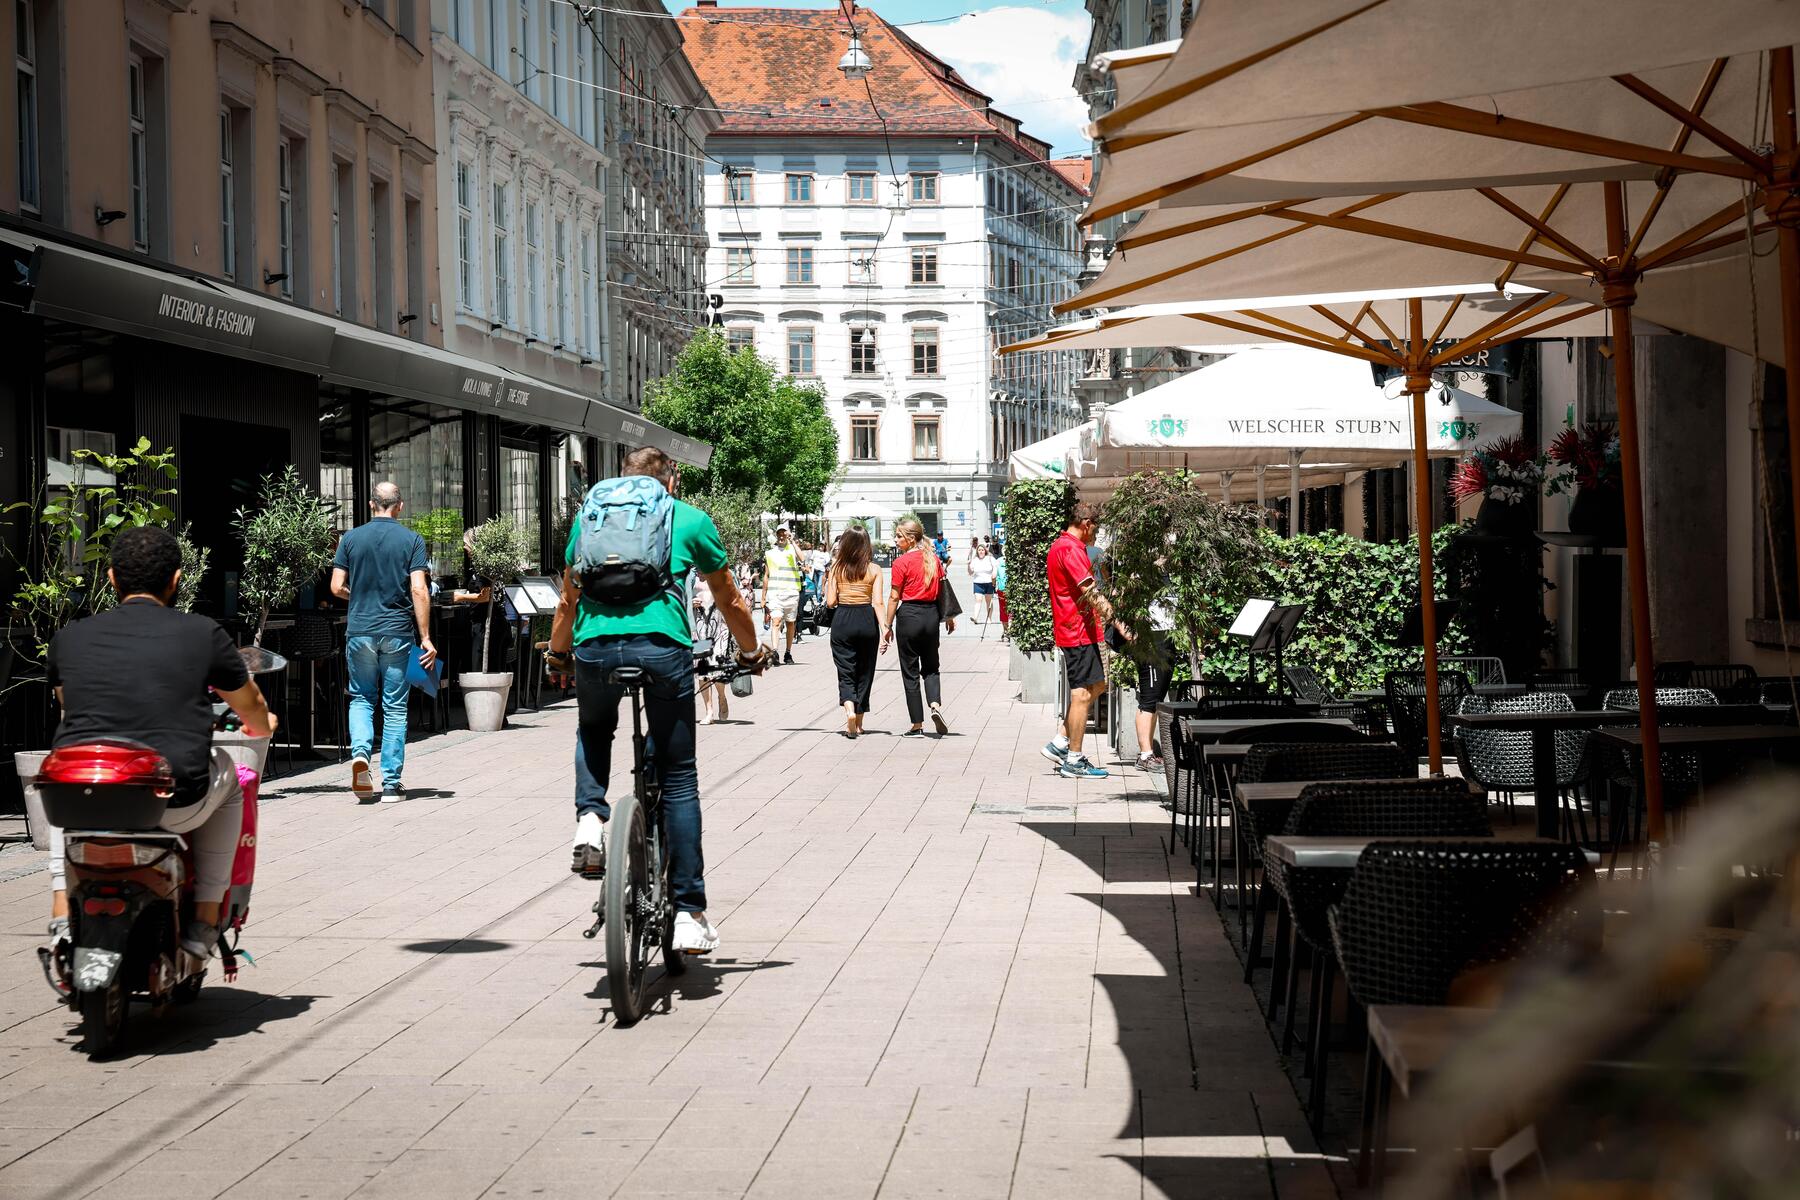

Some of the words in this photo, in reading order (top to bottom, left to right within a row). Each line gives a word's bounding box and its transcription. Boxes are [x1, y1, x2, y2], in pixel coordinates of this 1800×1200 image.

[158, 293, 206, 326] INTERIOR
[205, 306, 214, 328] &
[214, 309, 256, 337] FASHION
[1228, 419, 1325, 434] WELSCHER
[1335, 419, 1401, 434] STUB'N
[904, 486, 948, 505] BILLA
